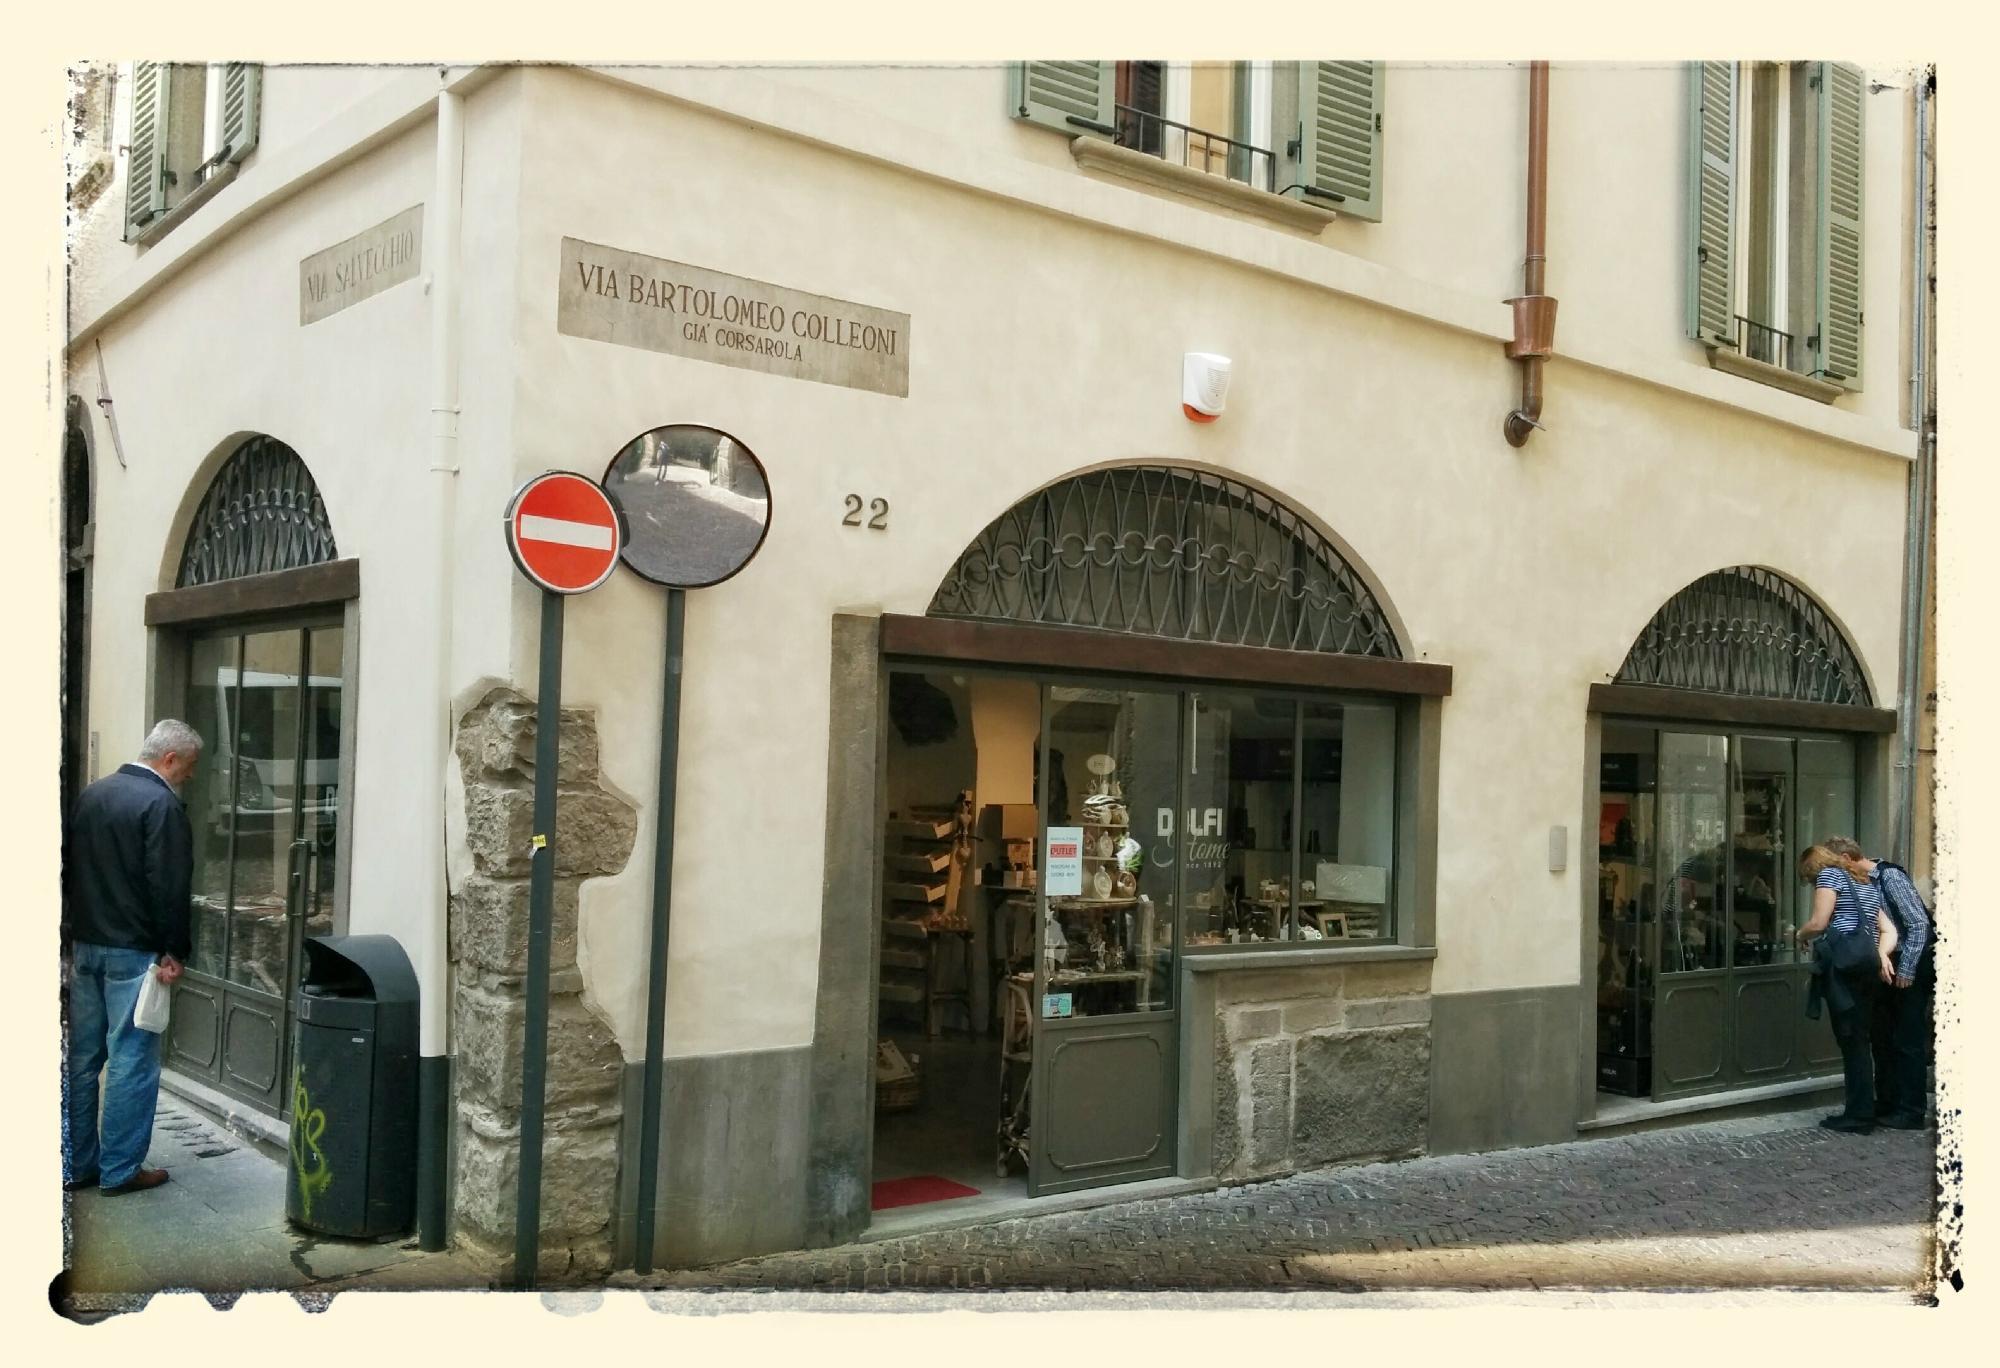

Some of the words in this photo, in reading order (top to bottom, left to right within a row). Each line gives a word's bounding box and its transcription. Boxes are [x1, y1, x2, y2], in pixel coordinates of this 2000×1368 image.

[307, 271, 329, 302] VIA
[335, 229, 414, 293] SALVECCHIO
[577, 261, 620, 299] VIA
[628, 273, 785, 333] BARTOLOMEO
[791, 310, 897, 356] COLLEONI
[715, 328, 803, 362] CORSAROLA
[842, 493, 889, 530] 22
[1157, 807, 1223, 837] DLFI
[1050, 847, 1077, 856] OUTLET
